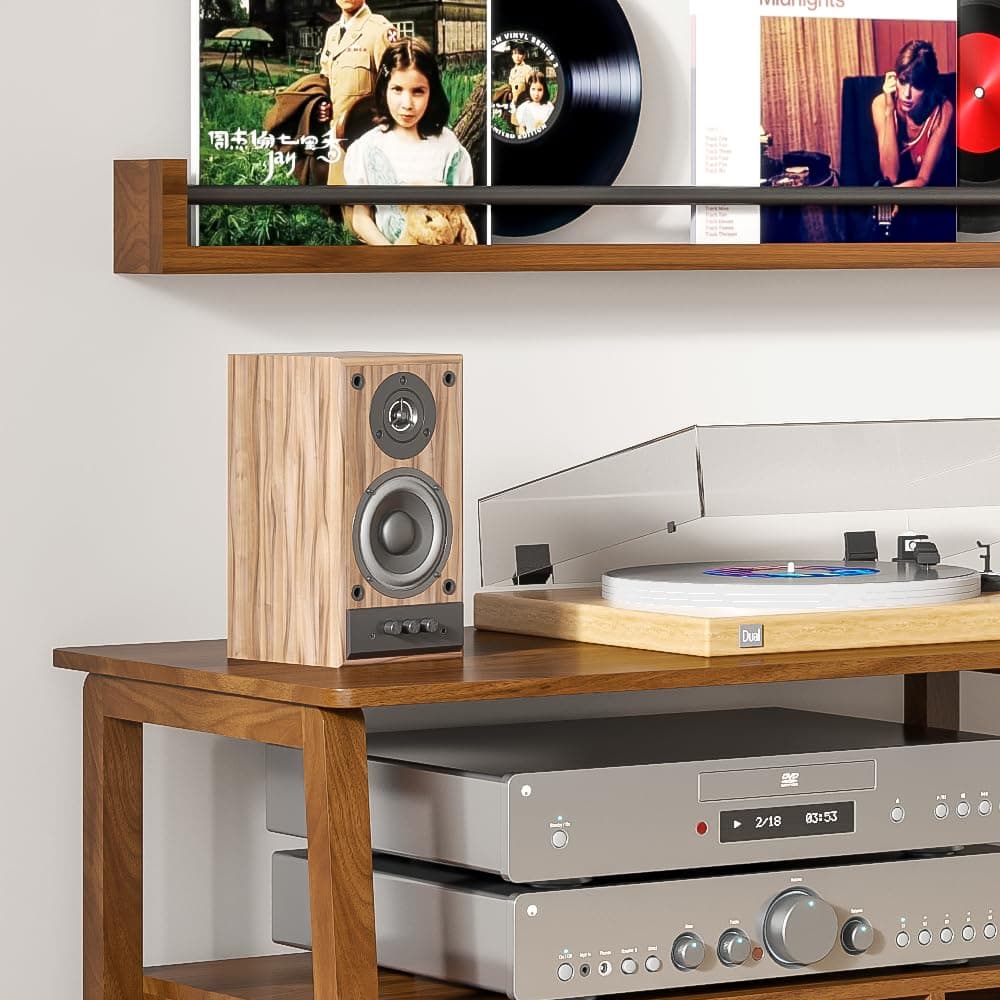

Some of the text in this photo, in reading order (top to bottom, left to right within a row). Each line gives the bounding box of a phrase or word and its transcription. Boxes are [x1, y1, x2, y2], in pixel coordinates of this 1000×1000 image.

[742, 628, 761, 643] Dual
[755, 811, 838, 828] 2/18 03:53
